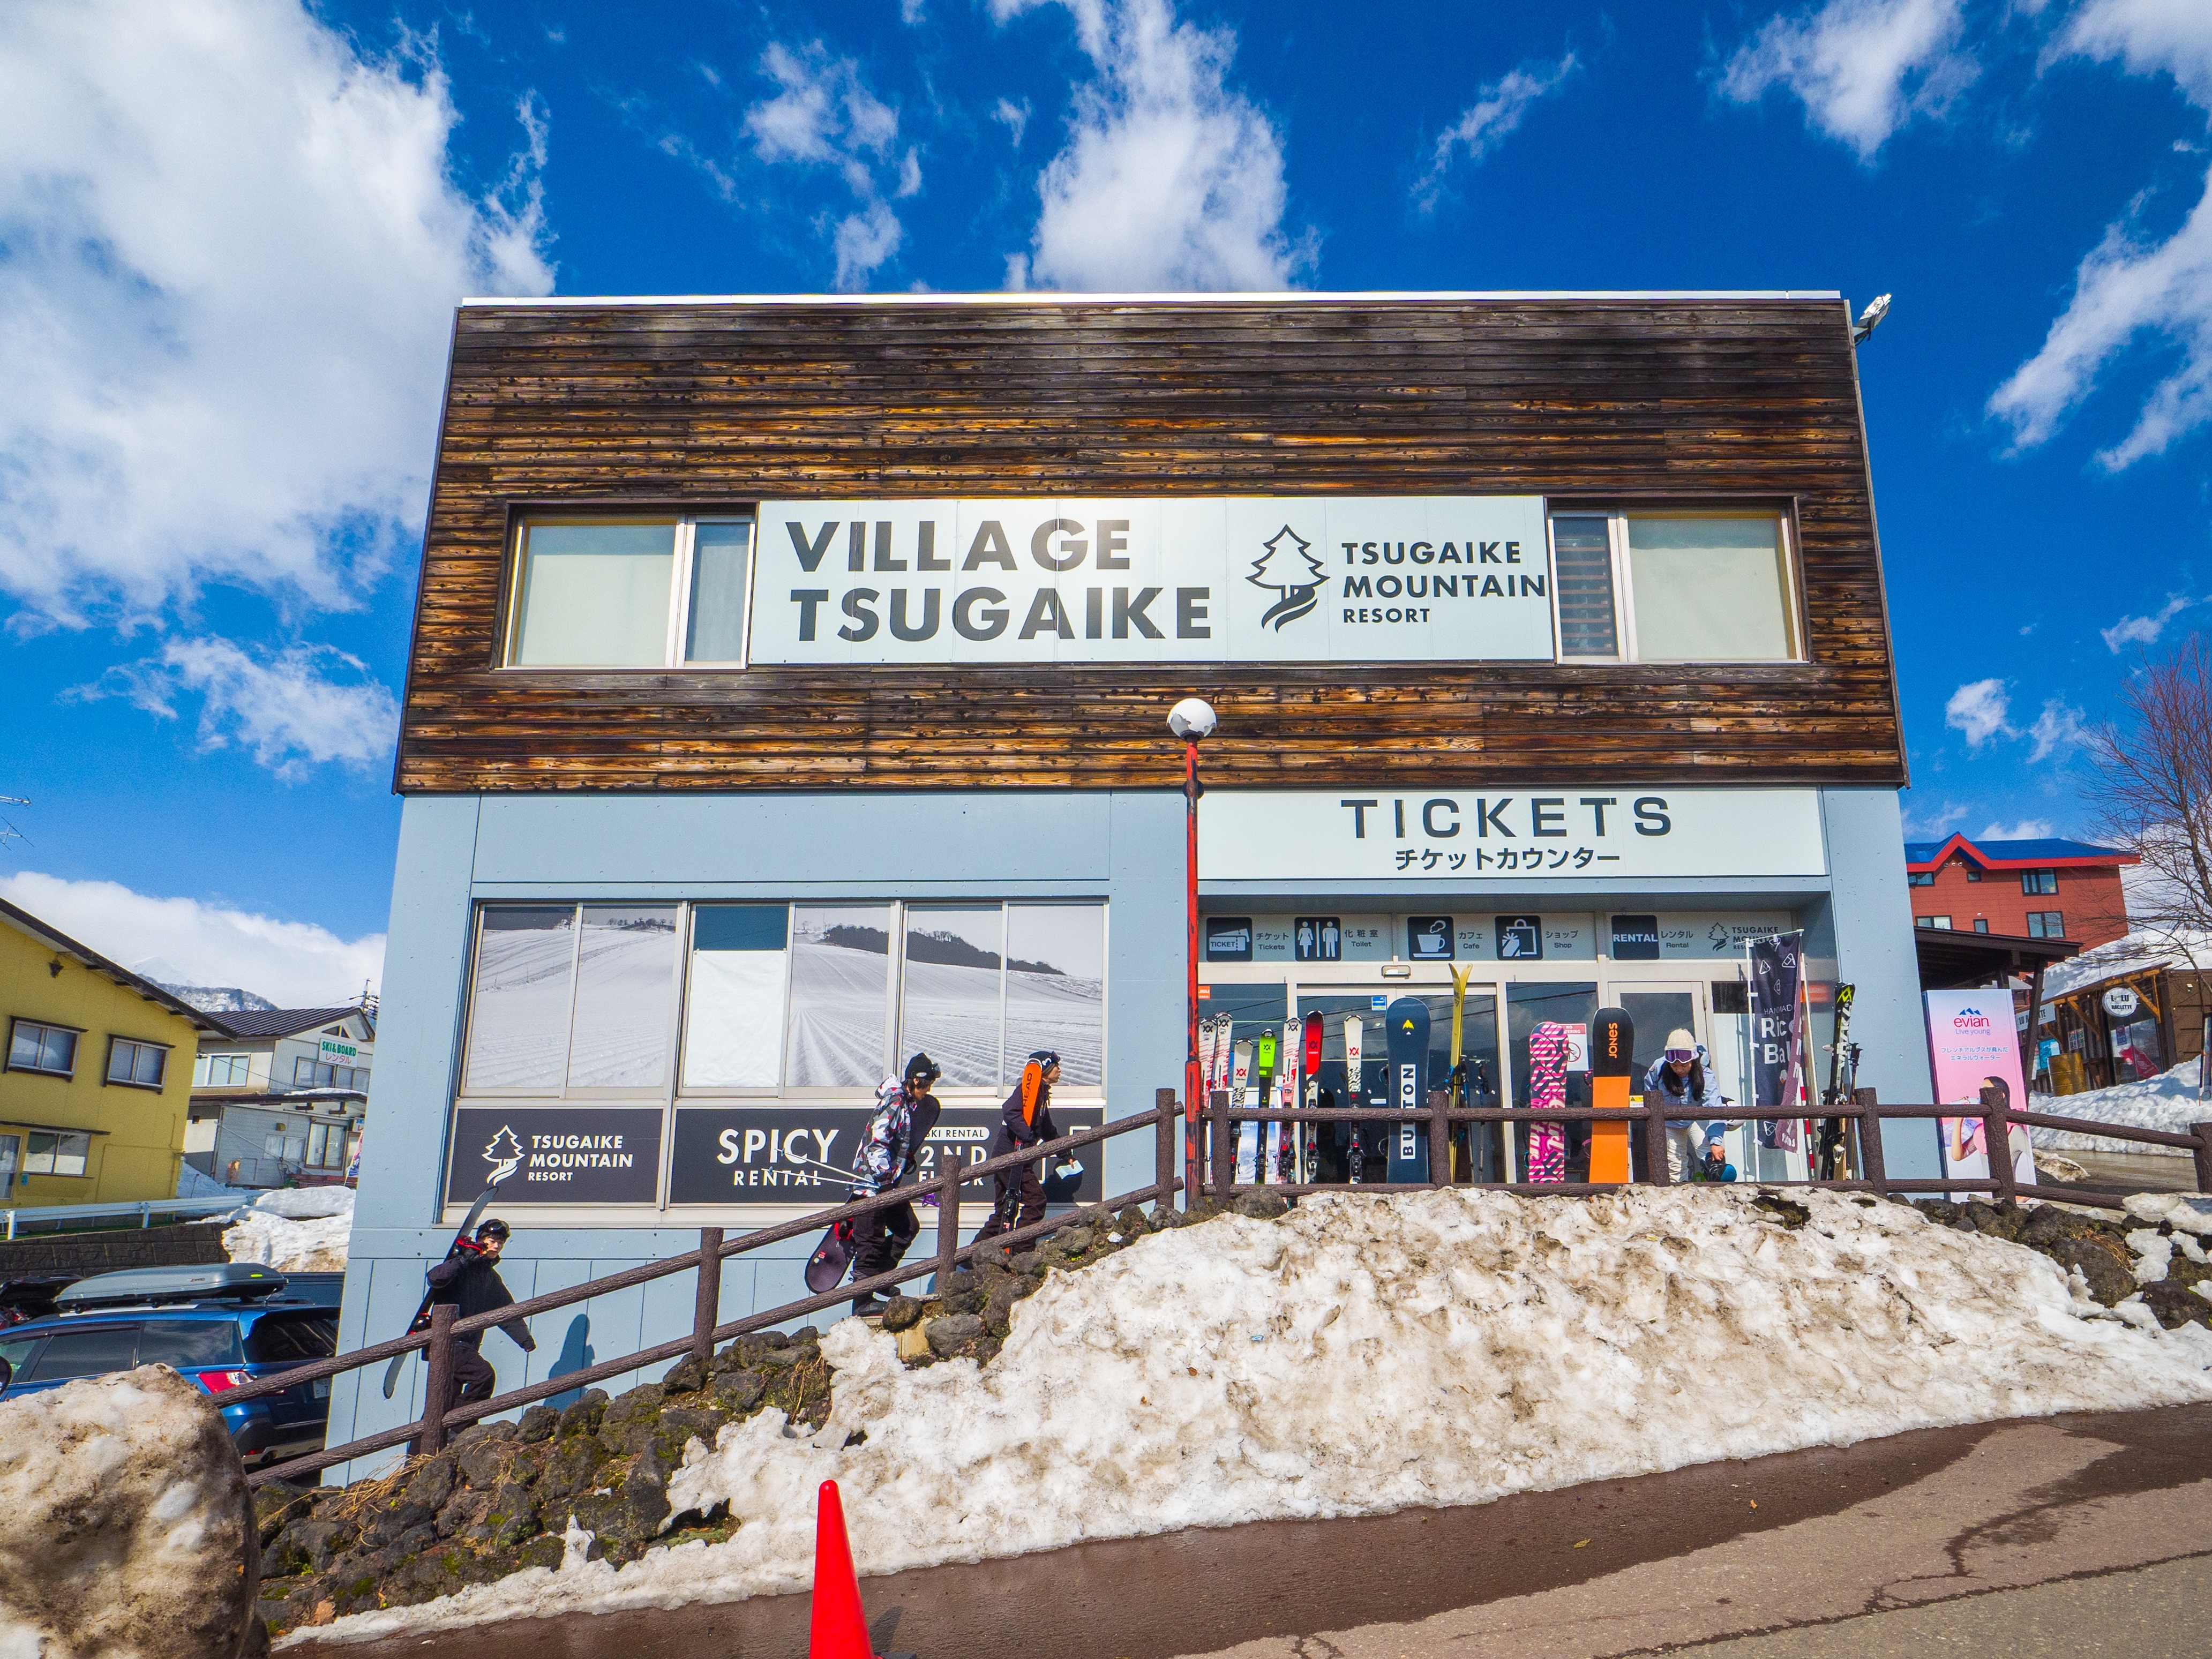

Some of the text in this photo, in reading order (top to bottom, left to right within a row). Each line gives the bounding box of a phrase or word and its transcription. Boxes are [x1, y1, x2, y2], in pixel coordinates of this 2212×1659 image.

[785, 519, 1129, 572] VILLAGE
[1341, 542, 1520, 565] TSUGAIKE
[1343, 575, 1546, 598] MOUNTAIN
[791, 587, 1211, 642] TSUGAIKE
[1343, 608, 1430, 623] RESORT
[1341, 797, 1671, 838] TICKETS
[1396, 847, 1619, 870] チケットカウンター
[1344, 929, 1378, 938] 化粧室
[1546, 930, 1578, 939] ショップ
[1613, 934, 1658, 942] RENTAL
[1661, 930, 1693, 939] レンタル
[1954, 1016, 1990, 1027] evian
[326, 1052, 351, 1064] レンタル
[1023, 1073, 1032, 1107] HEAD
[1403, 1068, 1414, 1156] BUTON
[532, 1135, 623, 1148] TSUGAIKE
[717, 1129, 839, 1164] SPICY
[529, 1154, 633, 1167] MOUNTAIN
[528, 1172, 573, 1181] RESORT
[734, 1170, 821, 1186] RENTAL
